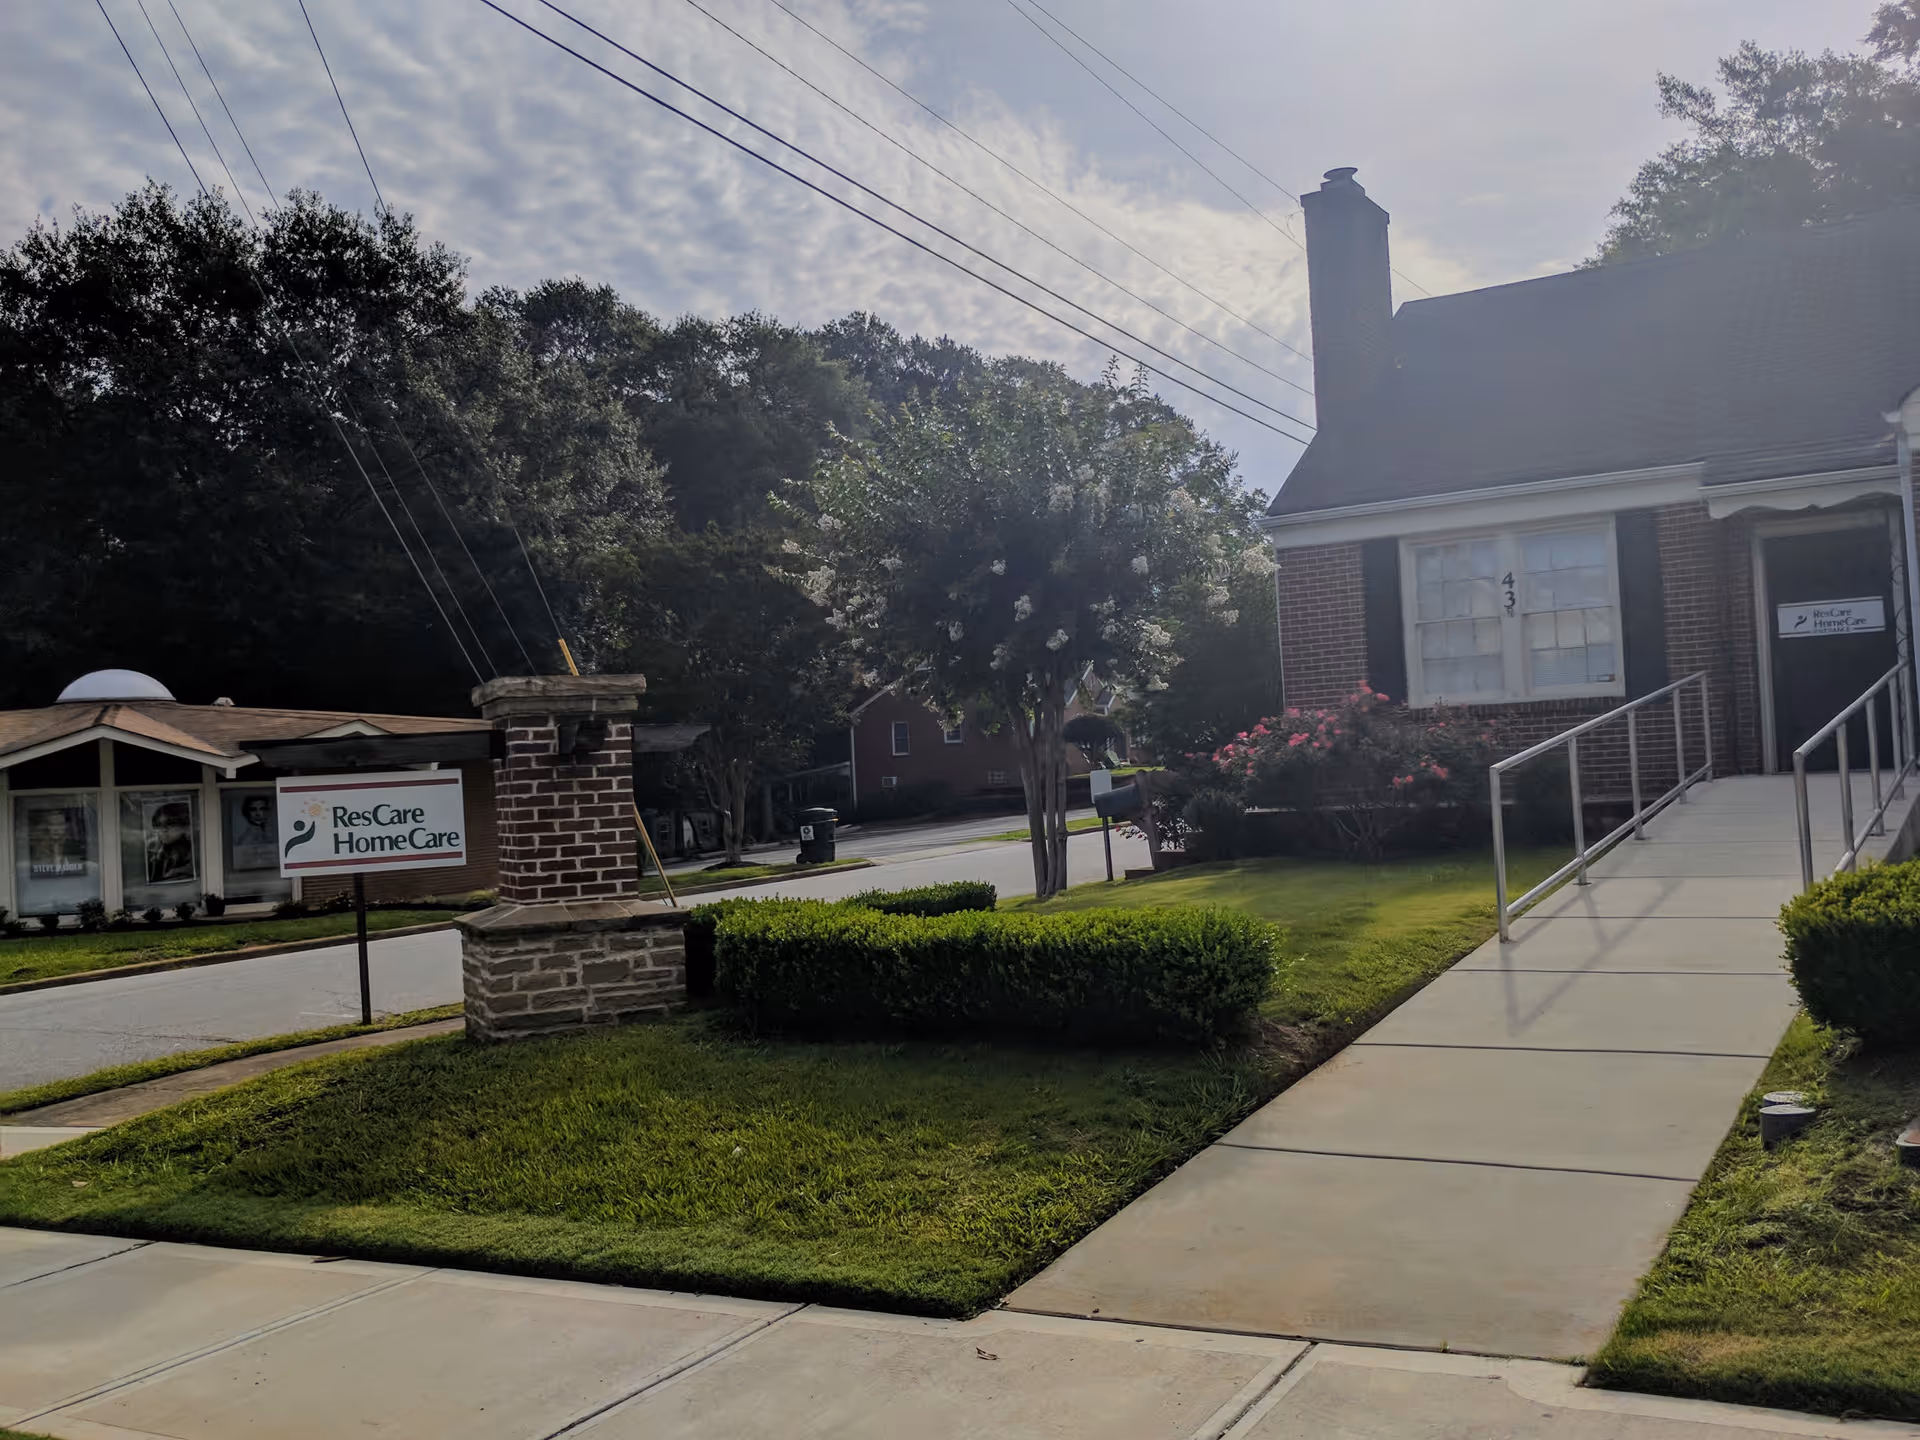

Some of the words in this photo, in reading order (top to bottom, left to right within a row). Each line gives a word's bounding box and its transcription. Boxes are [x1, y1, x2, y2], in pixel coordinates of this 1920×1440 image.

[1813, 608, 1851, 618] ResCare
[1814, 617, 1867, 628] HomeCare
[332, 803, 425, 828] ResCare
[333, 827, 460, 854] HomeCare
